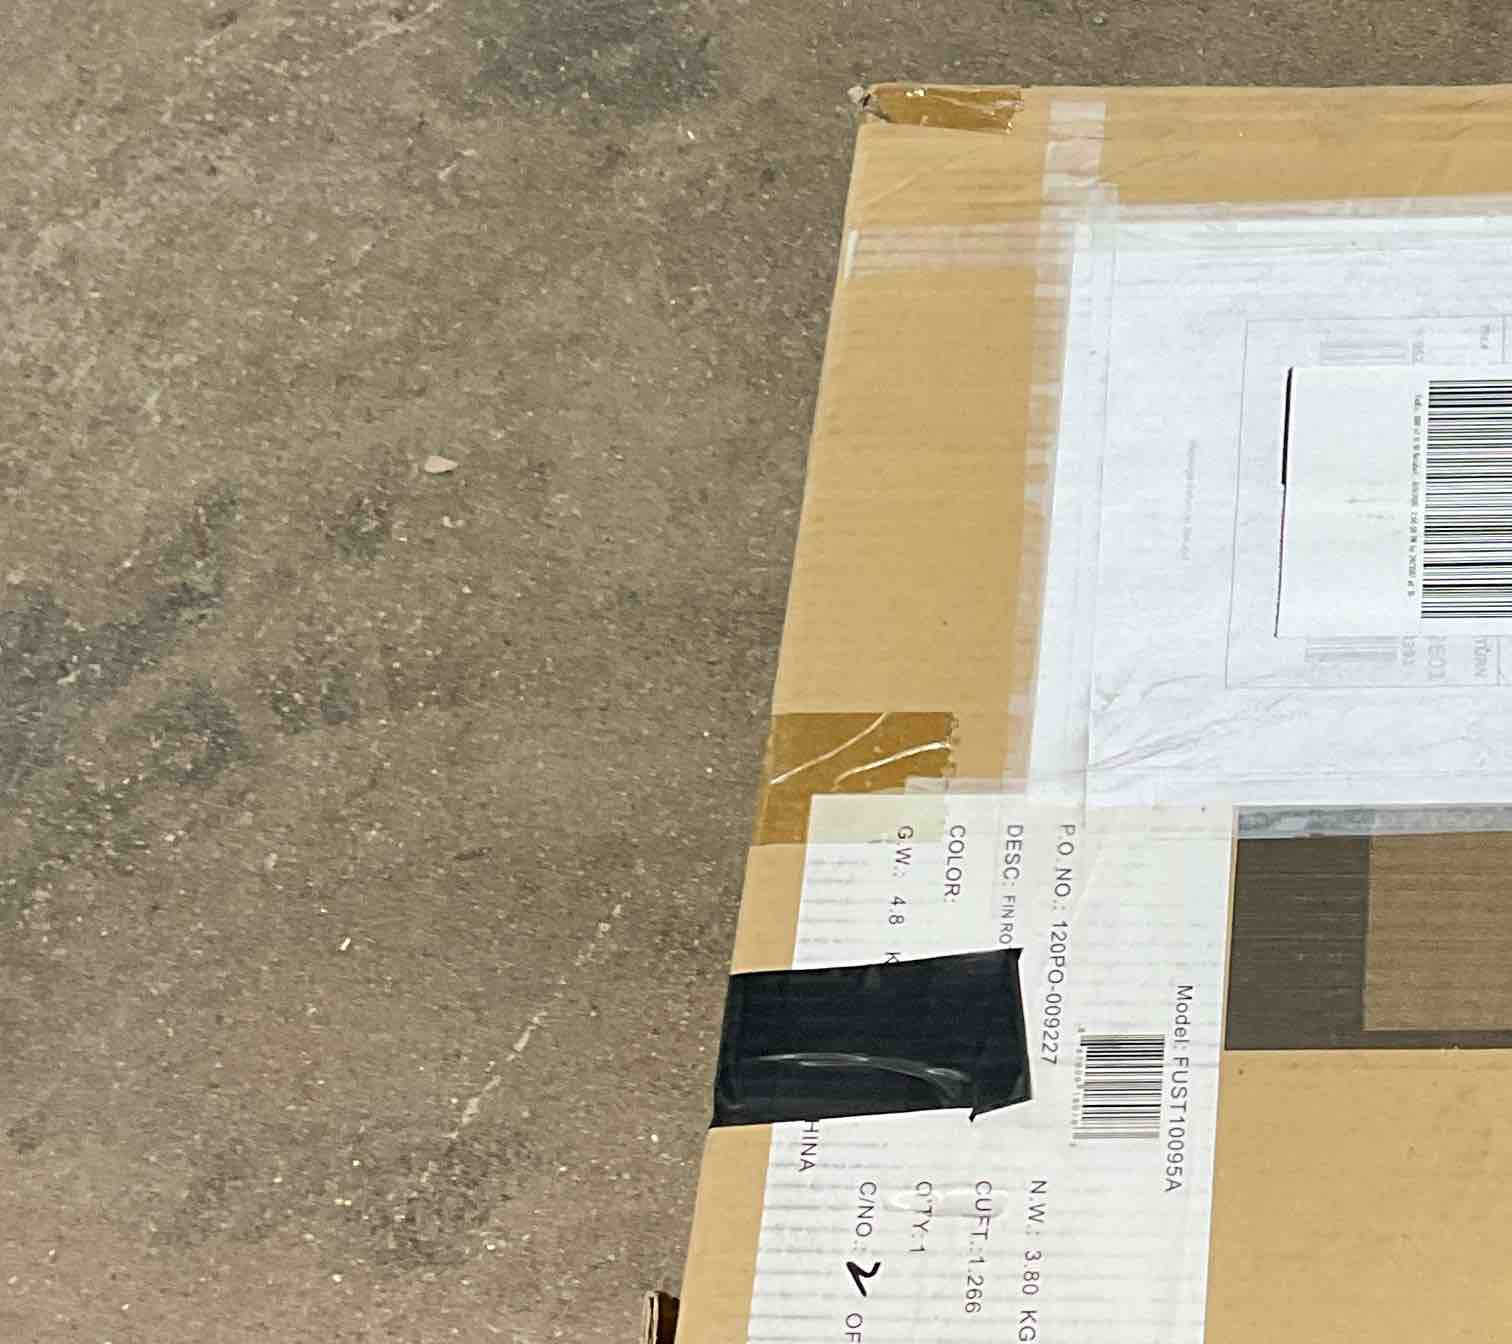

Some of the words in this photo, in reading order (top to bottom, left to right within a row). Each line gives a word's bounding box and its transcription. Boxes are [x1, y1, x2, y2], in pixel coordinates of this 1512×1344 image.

[943, 825, 966, 903] COLOR:
[1002, 824, 1023, 887] DESC:
[888, 896, 907, 925] 4.8
[1041, 920, 1068, 1065] 120PO-009227
[1173, 985, 1193, 1050] Model:
[798, 1120, 821, 1172] HINA
[1165, 1057, 1189, 1192] FUST10095A
[846, 1261, 881, 1297] 2
[1021, 1250, 1042, 1296] 3.80
[844, 1313, 864, 1343] OF
